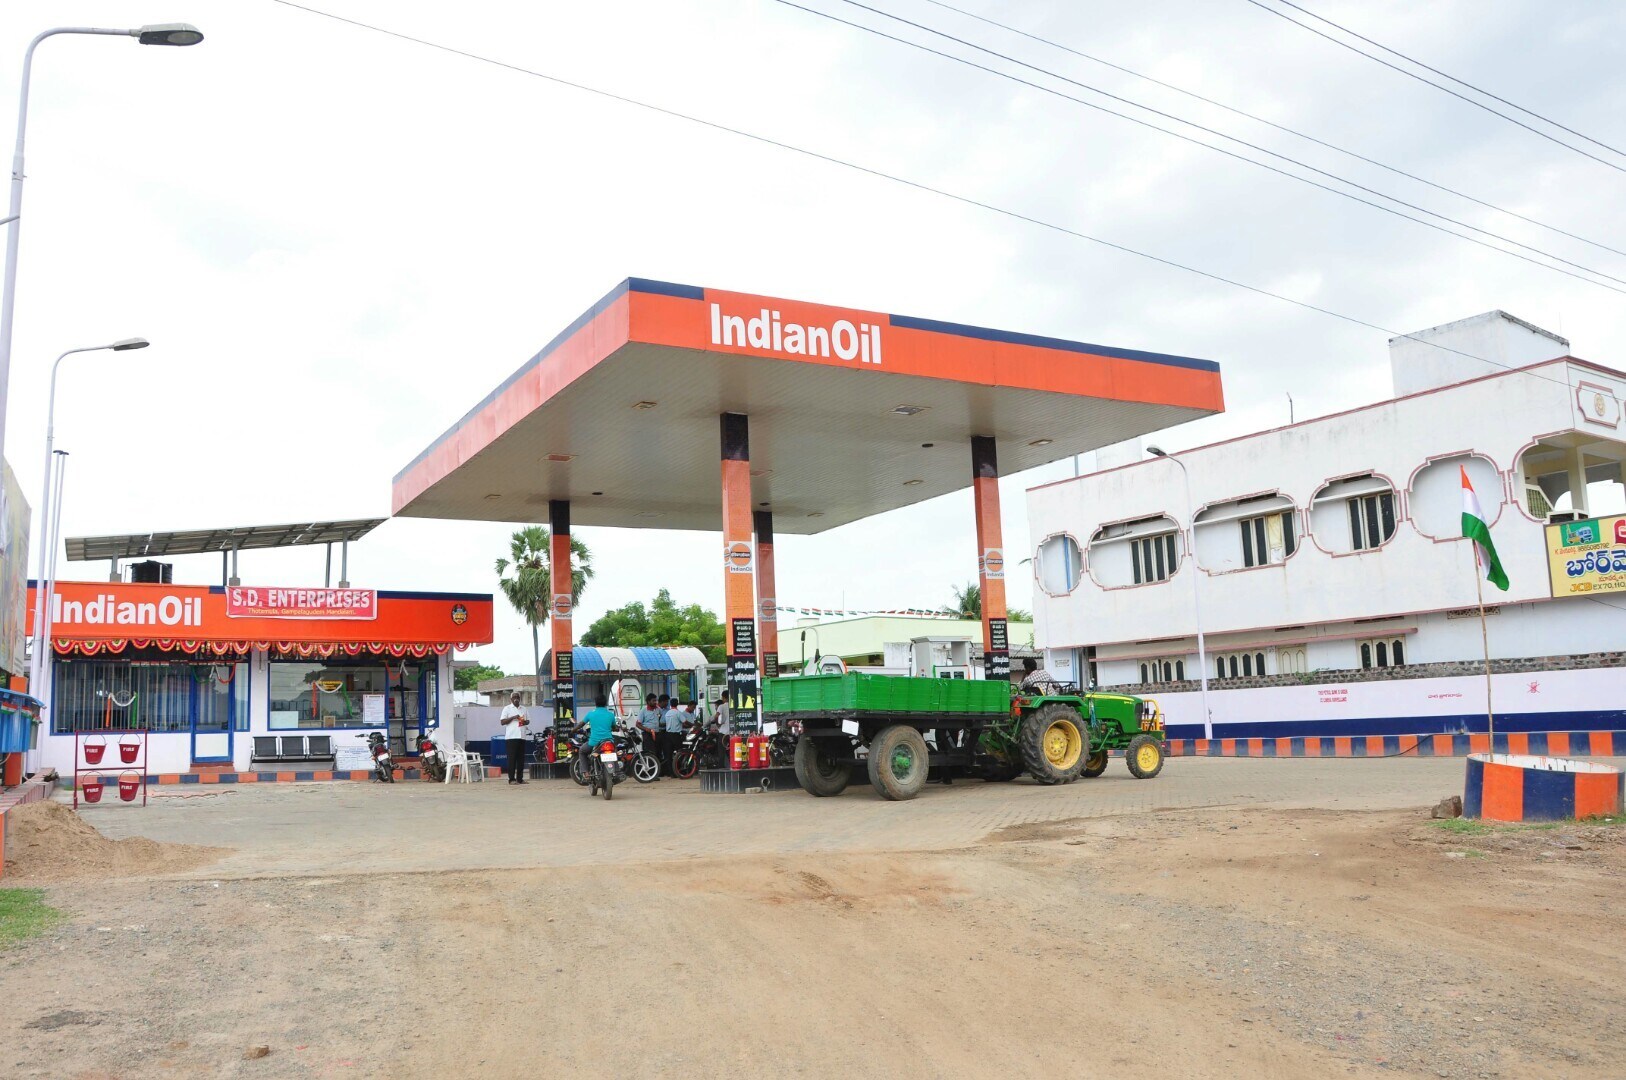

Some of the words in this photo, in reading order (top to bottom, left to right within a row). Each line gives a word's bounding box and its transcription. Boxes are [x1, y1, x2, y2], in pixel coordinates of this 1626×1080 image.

[710, 303, 882, 364] IndianOil
[232, 588, 263, 607] S.D.
[268, 589, 370, 608] ENTERPRISES
[1570, 582, 1592, 592] JCB
[52, 594, 202, 626] IndianOil
